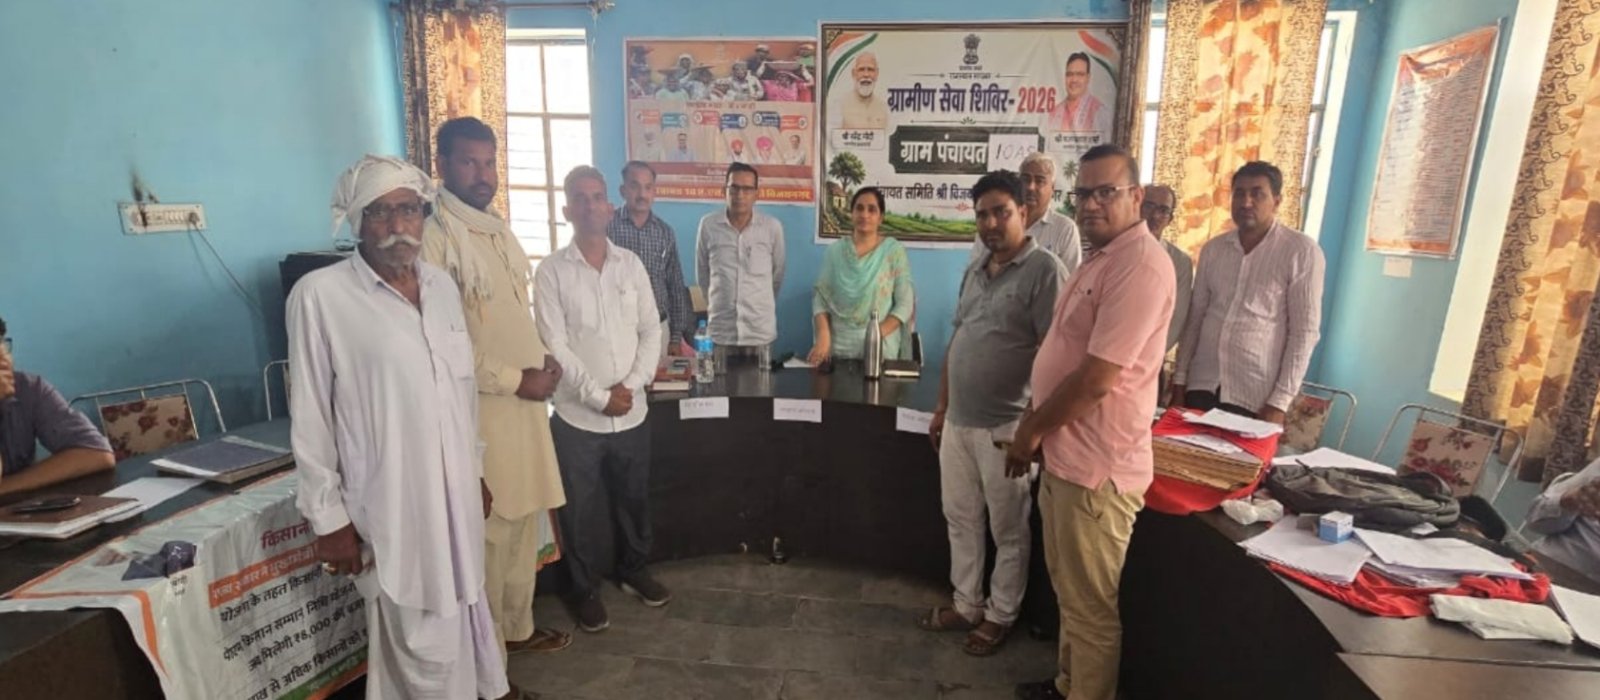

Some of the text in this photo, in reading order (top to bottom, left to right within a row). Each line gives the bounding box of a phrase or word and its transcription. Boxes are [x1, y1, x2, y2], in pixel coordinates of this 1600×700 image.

[887, 83, 935, 113] ग्रामीण
[940, 83, 965, 112] सेवा
[1017, 87, 1057, 113] 2026
[900, 133, 988, 165] ग्राम पंचायत
[905, 183, 934, 200] समिति
[936, 183, 948, 200] श्री
[263, 583, 288, 602] तहत
[269, 677, 281, 694] से
[282, 660, 313, 687] अधिक
